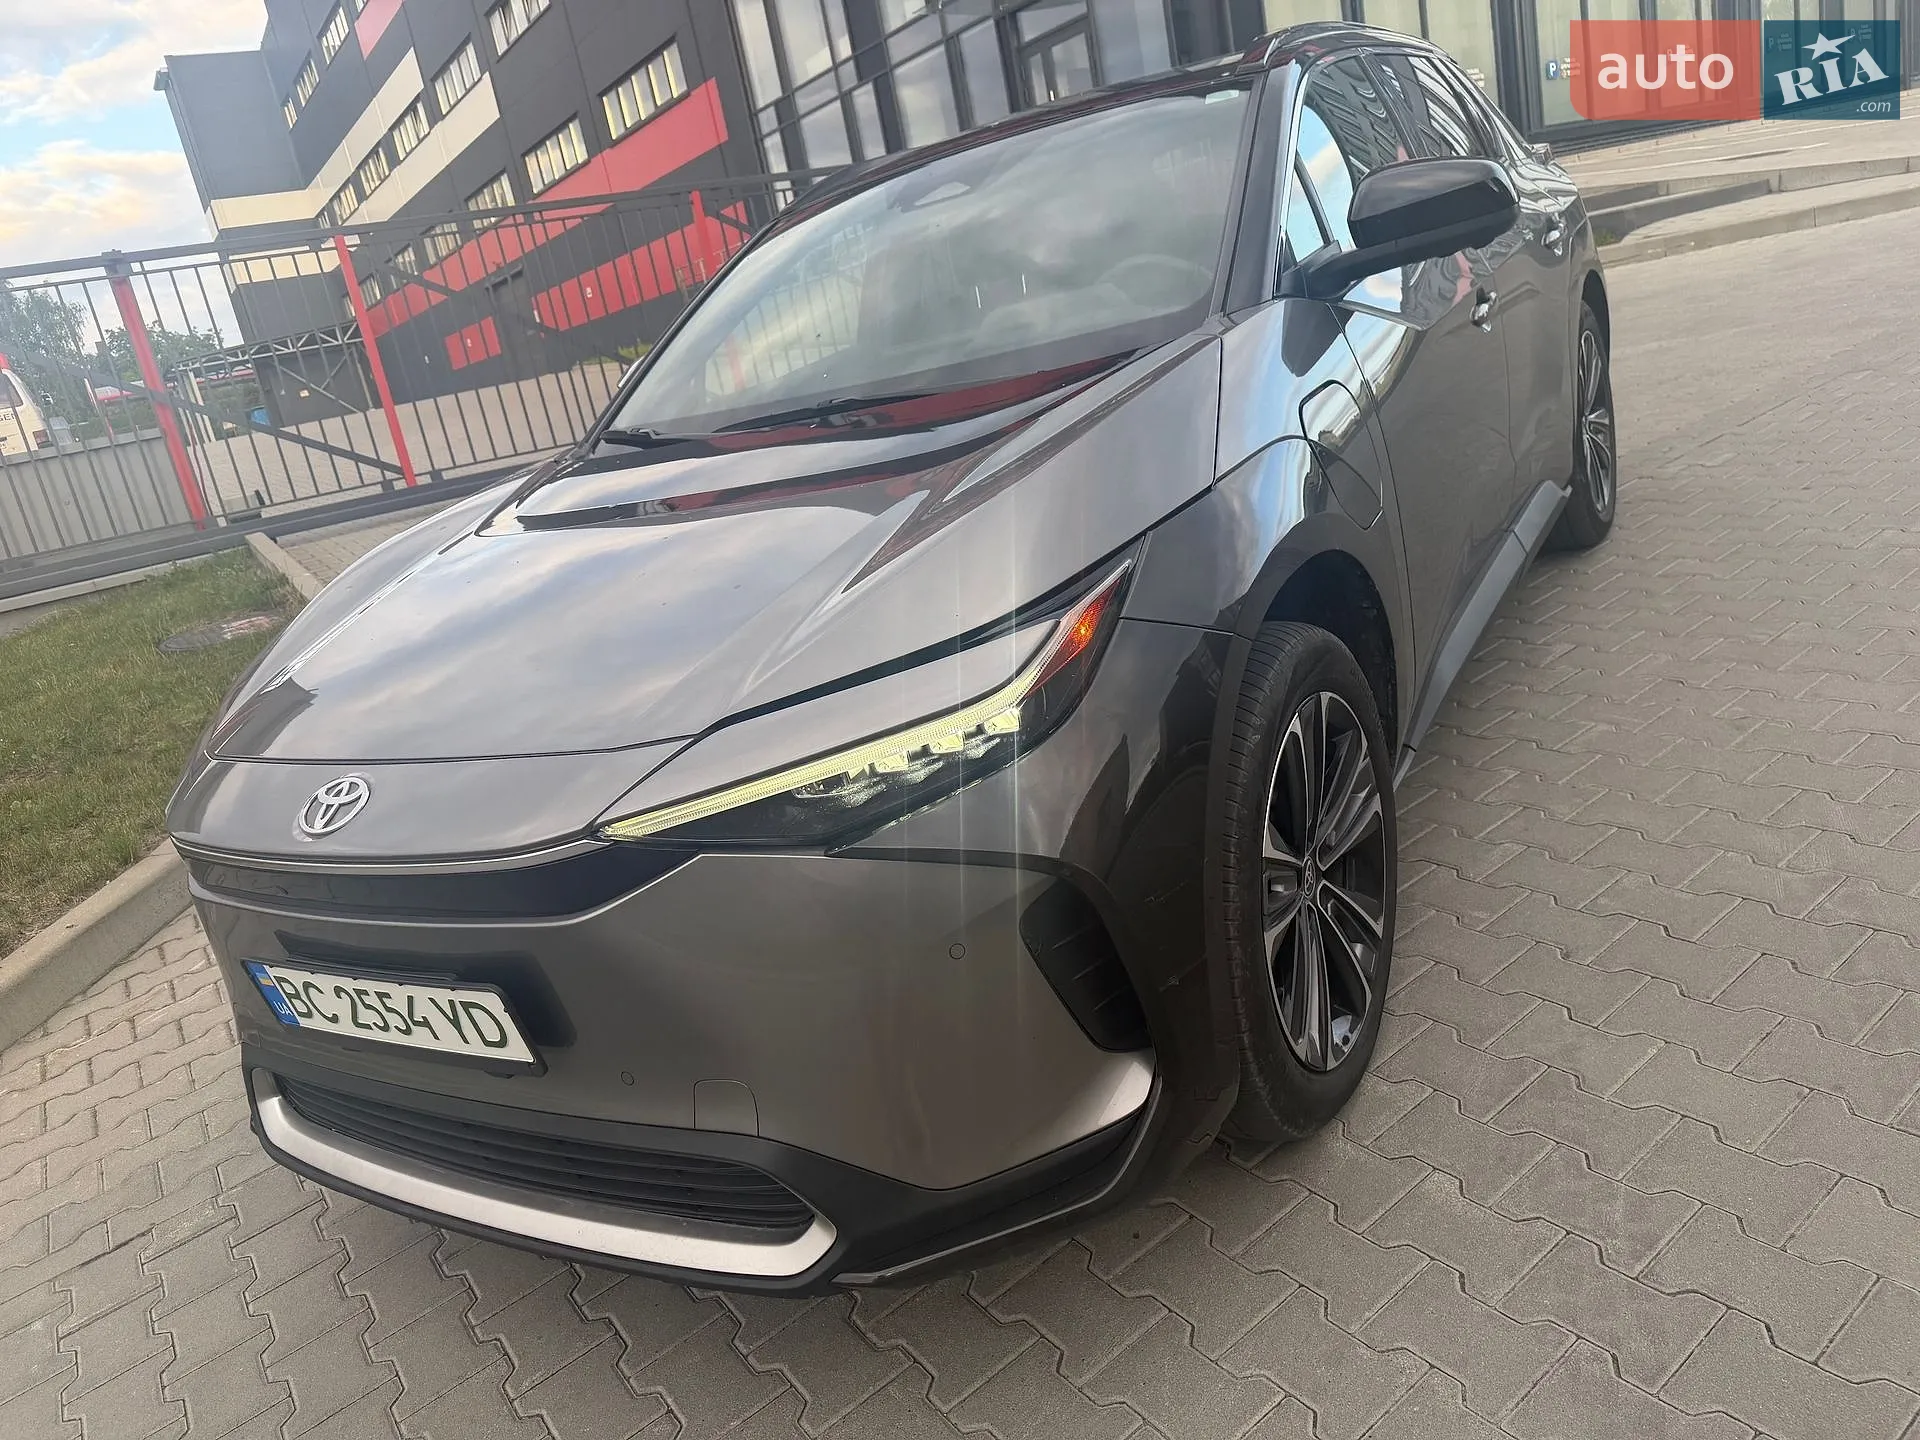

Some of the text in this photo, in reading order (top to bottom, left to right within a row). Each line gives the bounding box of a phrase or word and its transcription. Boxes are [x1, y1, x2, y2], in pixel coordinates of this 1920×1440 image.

[273, 976, 508, 1048] BC 2554 YD
[274, 1000, 293, 1016] UA
